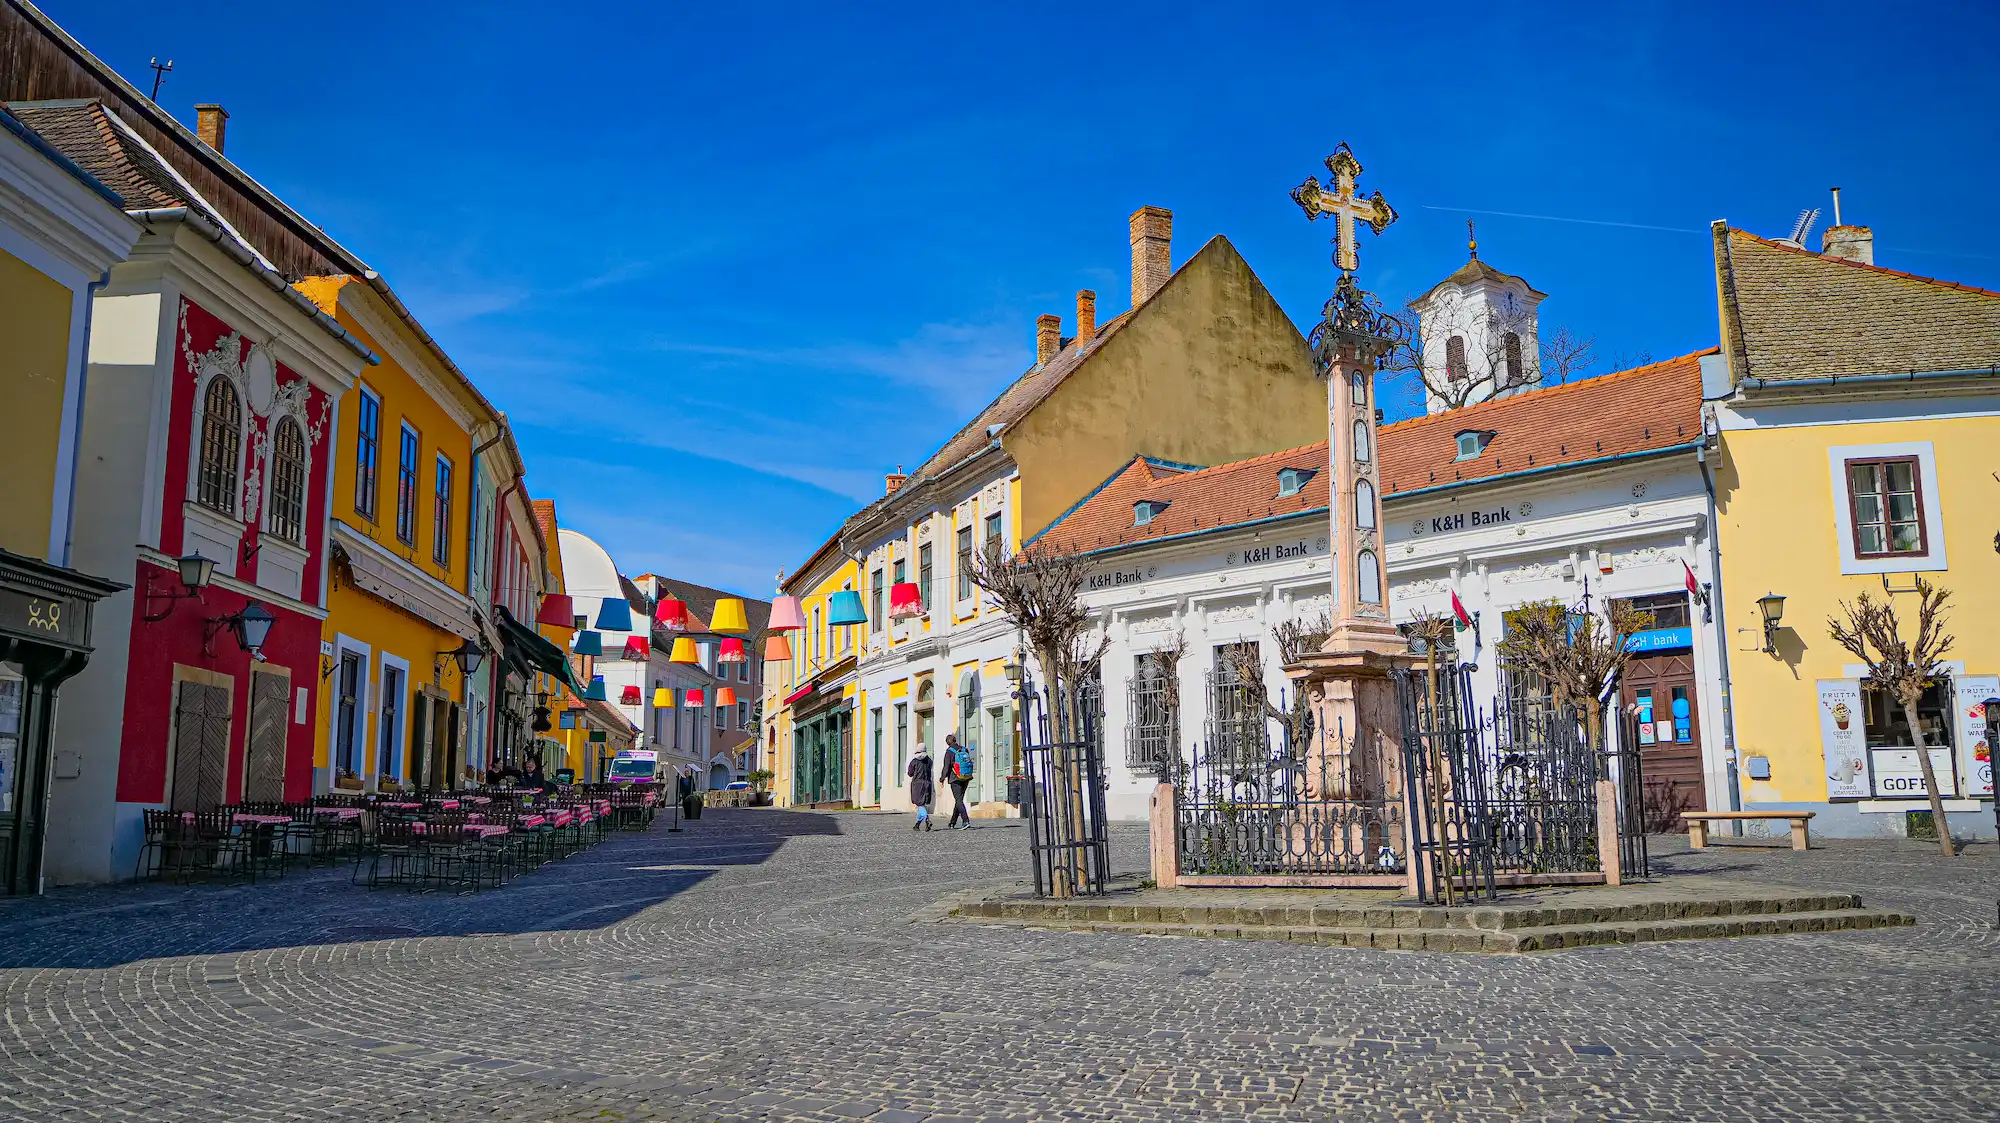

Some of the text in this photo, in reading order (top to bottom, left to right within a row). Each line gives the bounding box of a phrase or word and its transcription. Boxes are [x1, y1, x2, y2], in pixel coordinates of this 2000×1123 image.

[1432, 506, 1511, 533] K&H Bank
[1244, 541, 1308, 564] K&H Bank
[1090, 569, 1142, 588] K&H Bank
[1653, 632, 1680, 646] bank
[1883, 777, 1927, 790] GOF
